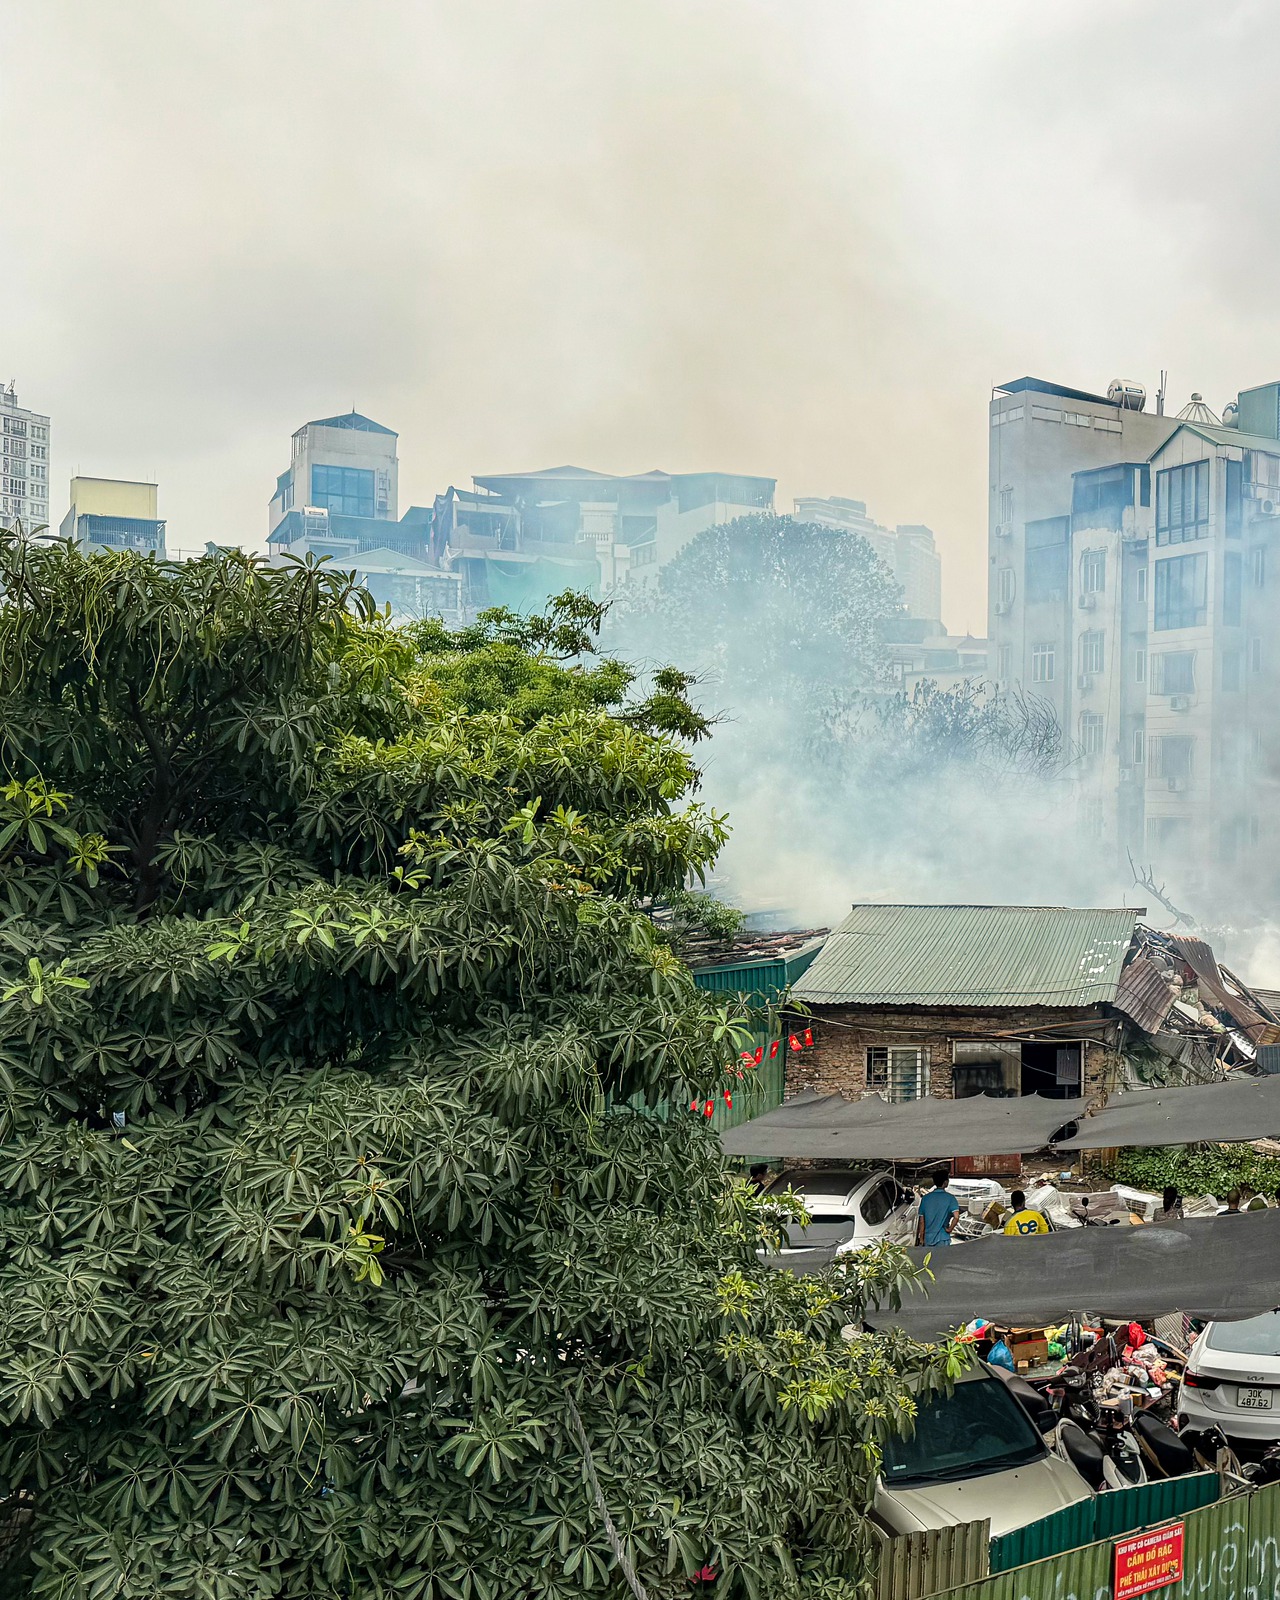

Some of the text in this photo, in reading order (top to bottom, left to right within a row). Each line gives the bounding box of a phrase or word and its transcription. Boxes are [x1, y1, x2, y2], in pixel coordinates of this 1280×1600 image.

[1016, 1220, 1037, 1234] be
[1241, 1398, 1268, 1407] 487.62
[1248, 1390, 1262, 1398] 30K
[1118, 1527, 1182, 1555] KHU VỰC CÓ CAMERA GIÁM SÁT
[1127, 1542, 1172, 1568] CẤM ĐỔ RÁC
[1120, 1572, 1133, 1588] PHẾ
[1134, 1566, 1147, 1583] THẢI
[1149, 1563, 1160, 1578] XÂY
